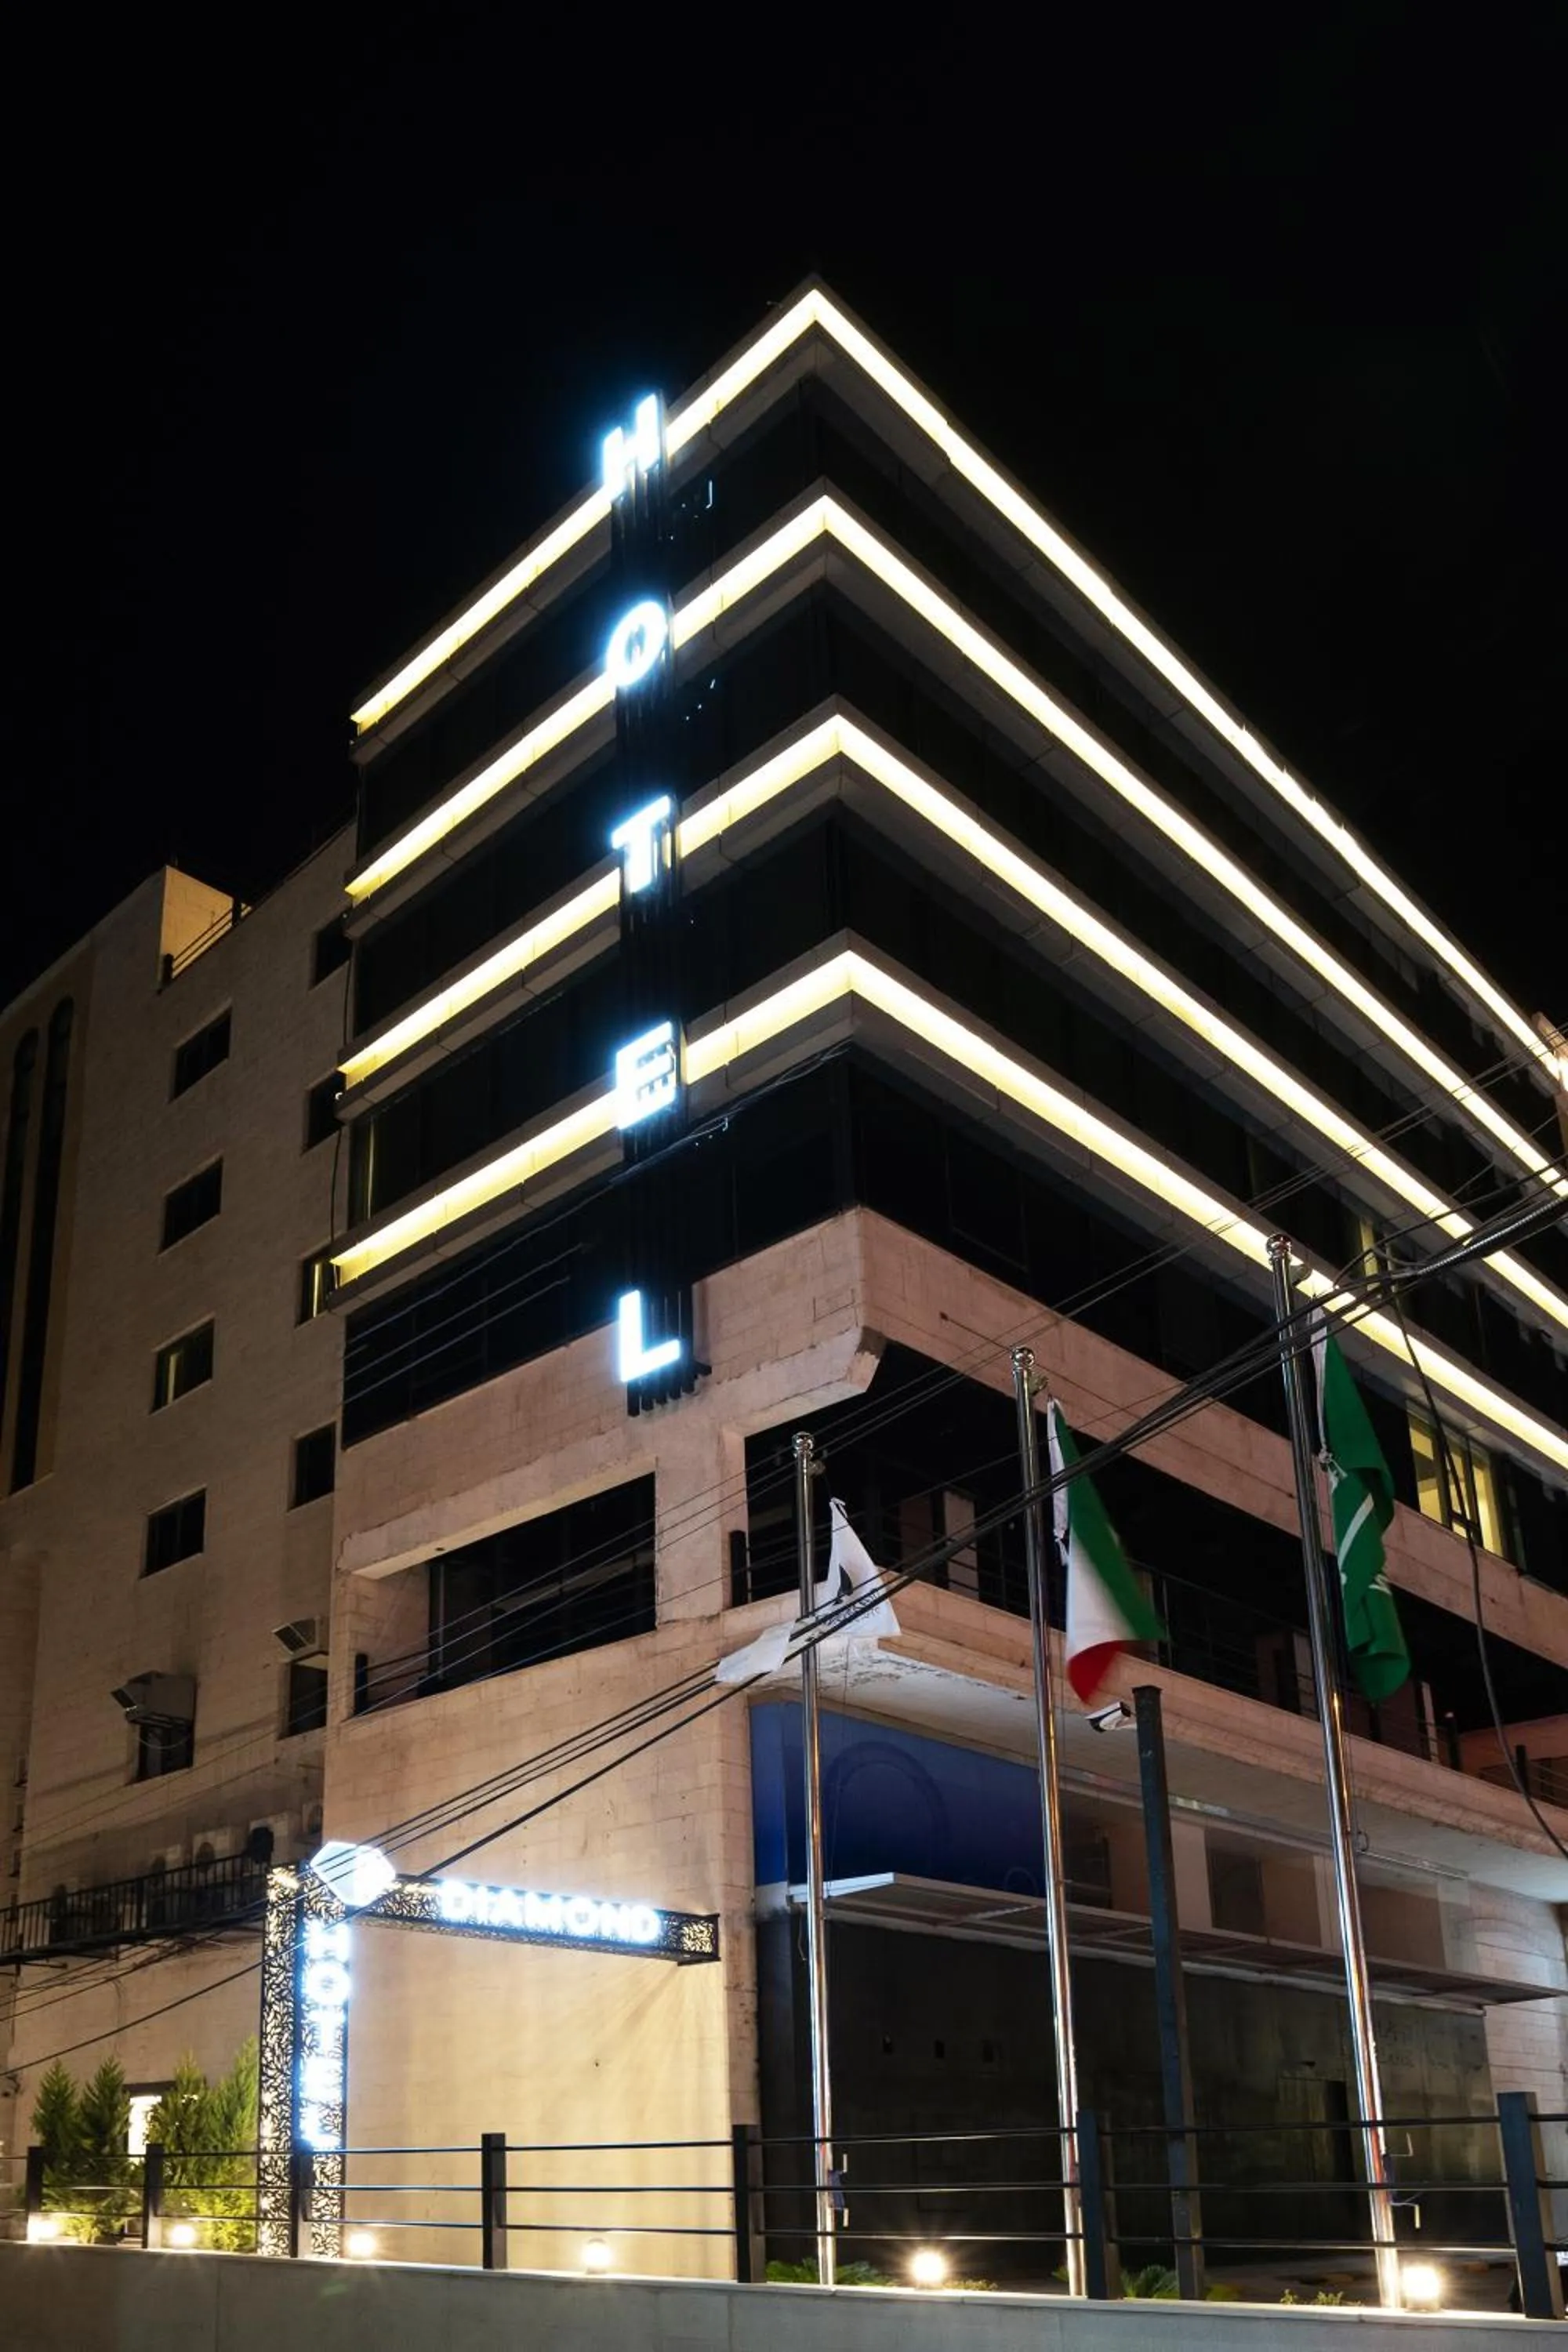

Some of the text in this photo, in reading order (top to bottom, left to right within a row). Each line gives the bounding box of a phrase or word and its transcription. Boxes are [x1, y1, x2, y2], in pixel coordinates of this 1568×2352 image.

[602, 392, 681, 1383] HOTEL
[441, 1879, 662, 1944] DIAMOND
[301, 1918, 350, 2151] HOTEL
